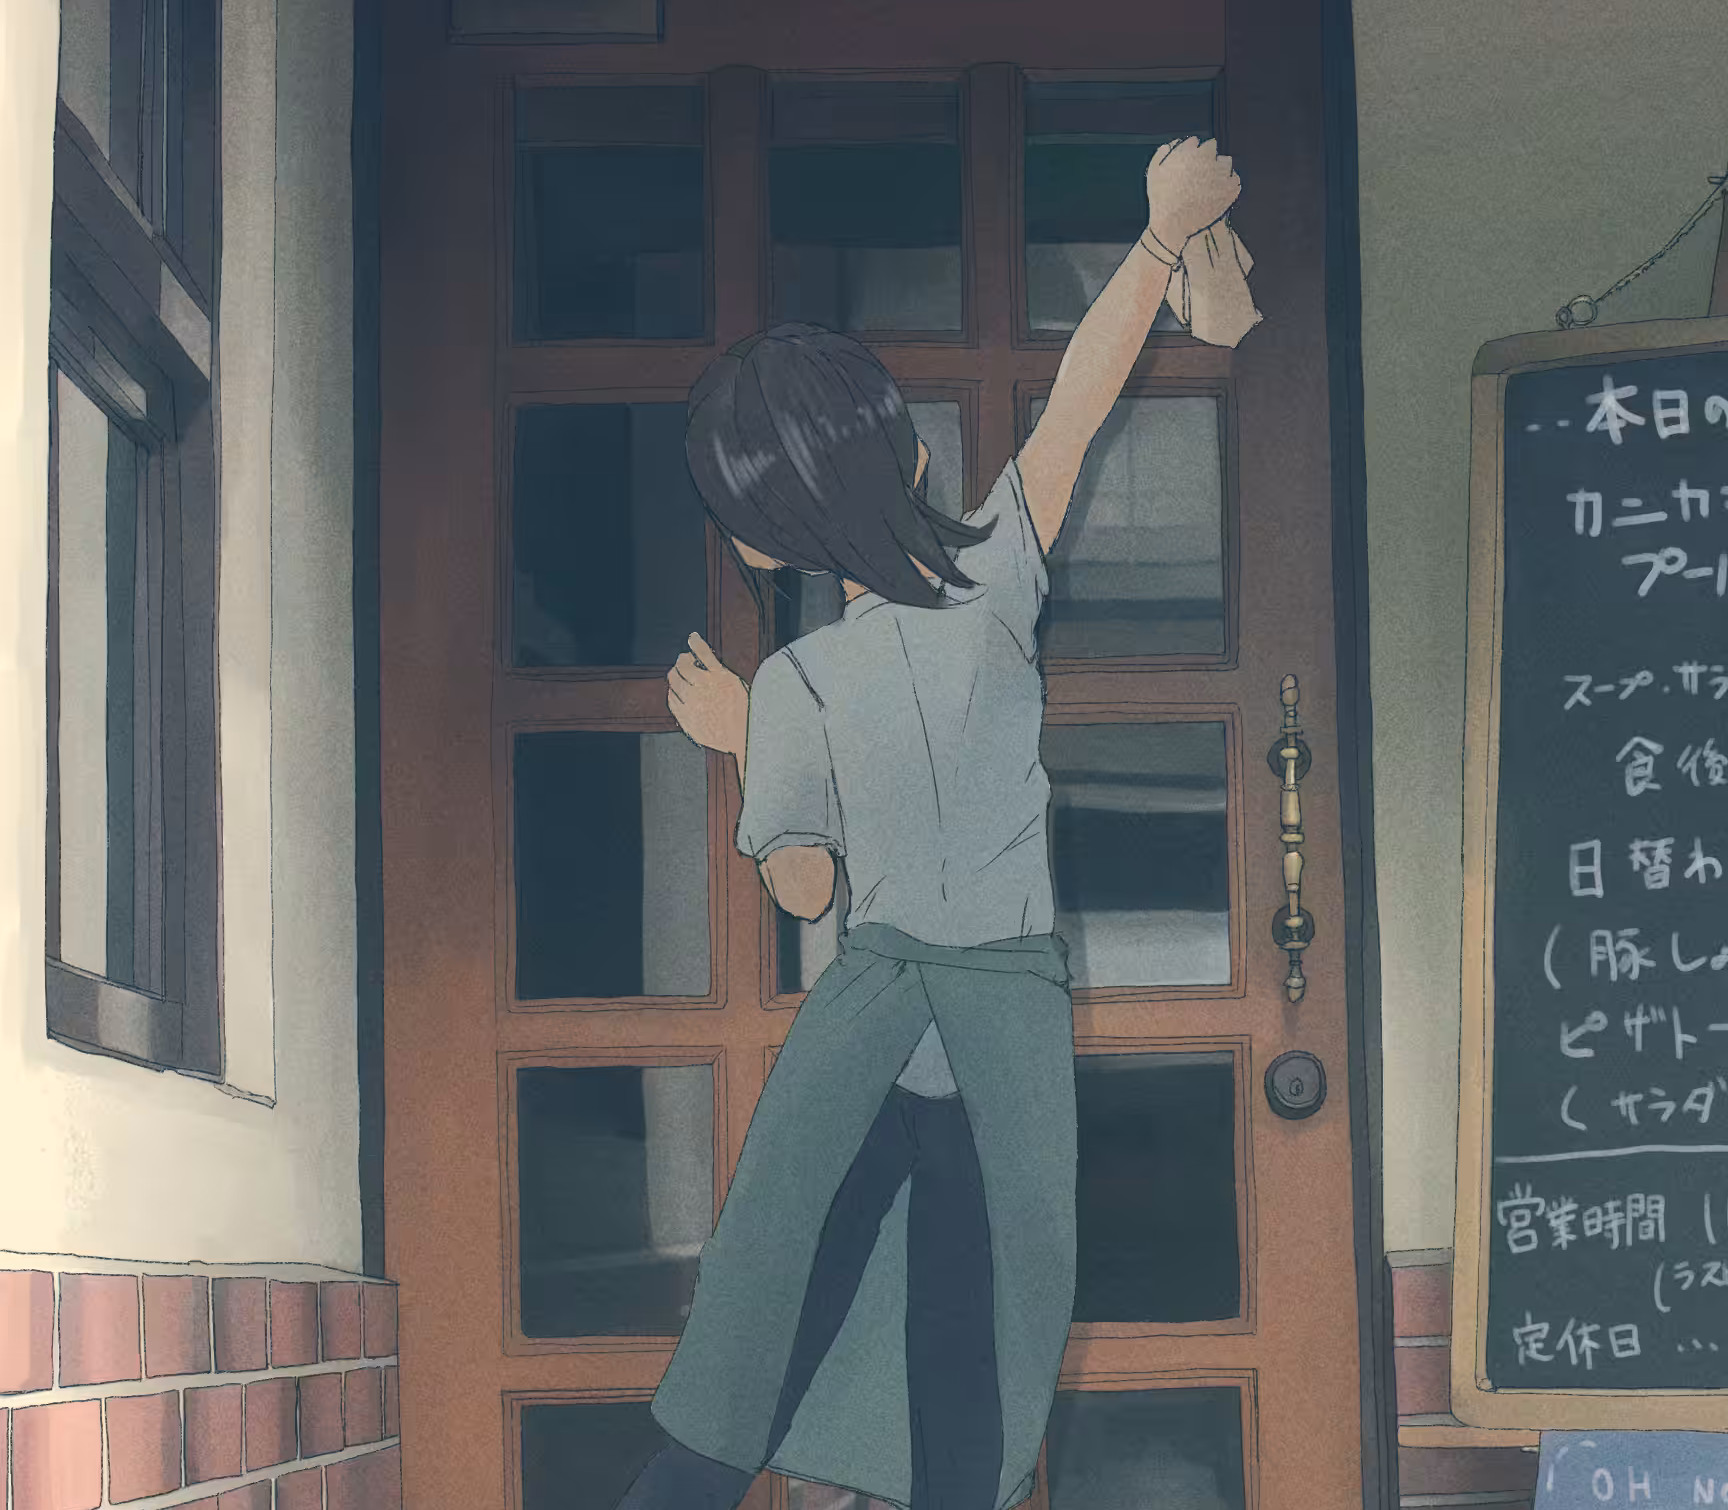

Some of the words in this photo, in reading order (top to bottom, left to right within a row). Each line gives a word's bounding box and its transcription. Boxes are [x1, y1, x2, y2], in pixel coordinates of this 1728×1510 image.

[1496, 1182, 1666, 1255] 営業時間
[1590, 1465, 1652, 1503] OH
